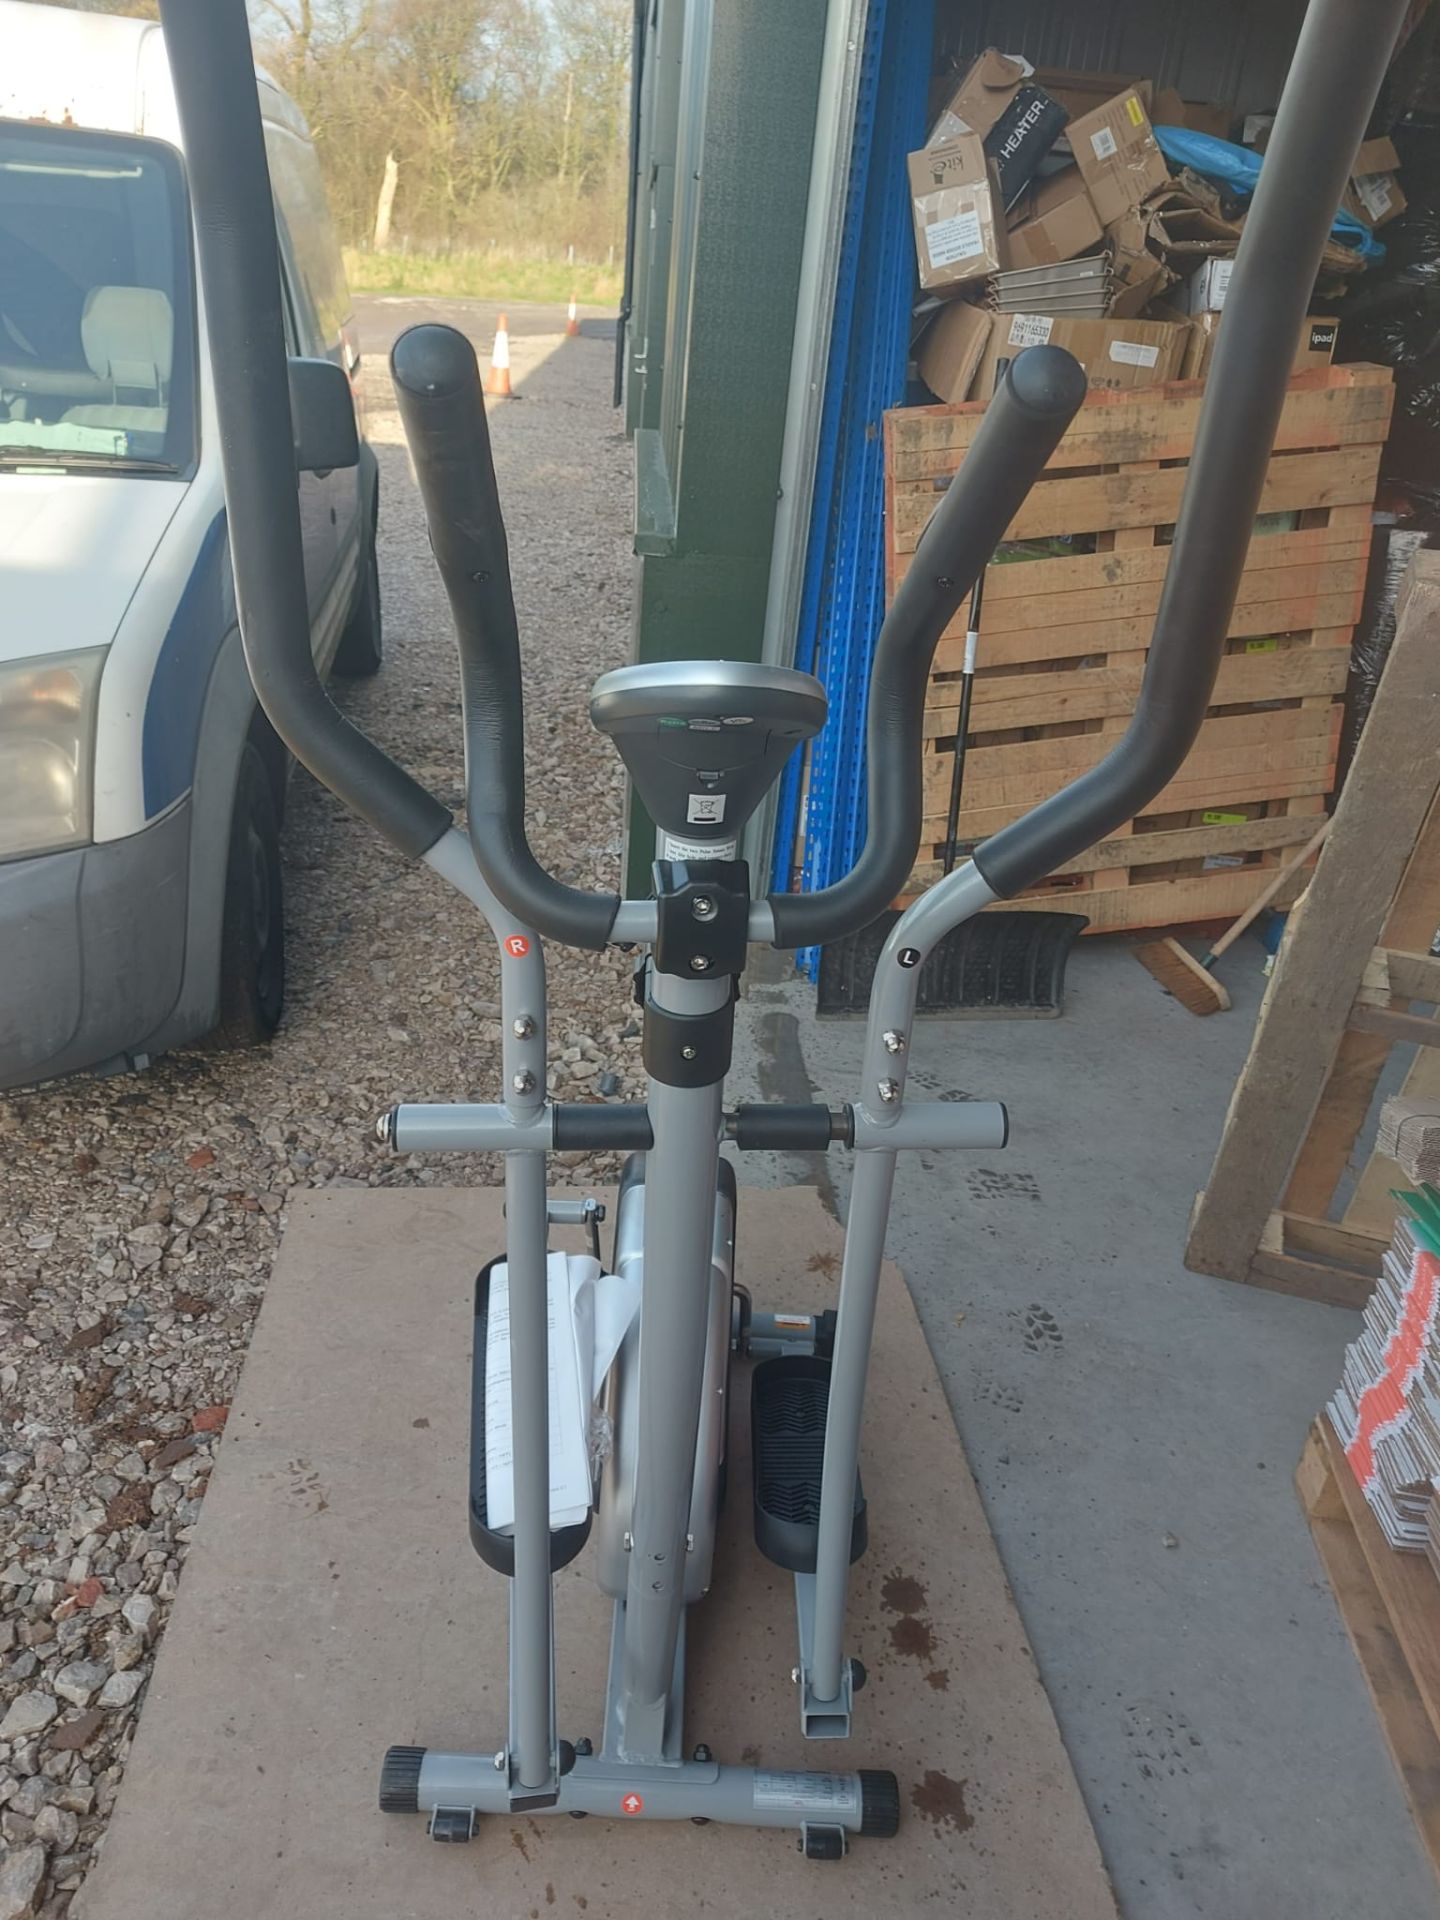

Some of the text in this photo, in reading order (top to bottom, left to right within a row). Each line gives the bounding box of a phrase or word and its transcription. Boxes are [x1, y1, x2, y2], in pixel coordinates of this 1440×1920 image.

[1000, 100, 1045, 159] HEATER
[1312, 331, 1334, 345] ipad
[511, 939, 526, 953] R
[903, 950, 914, 964] L
